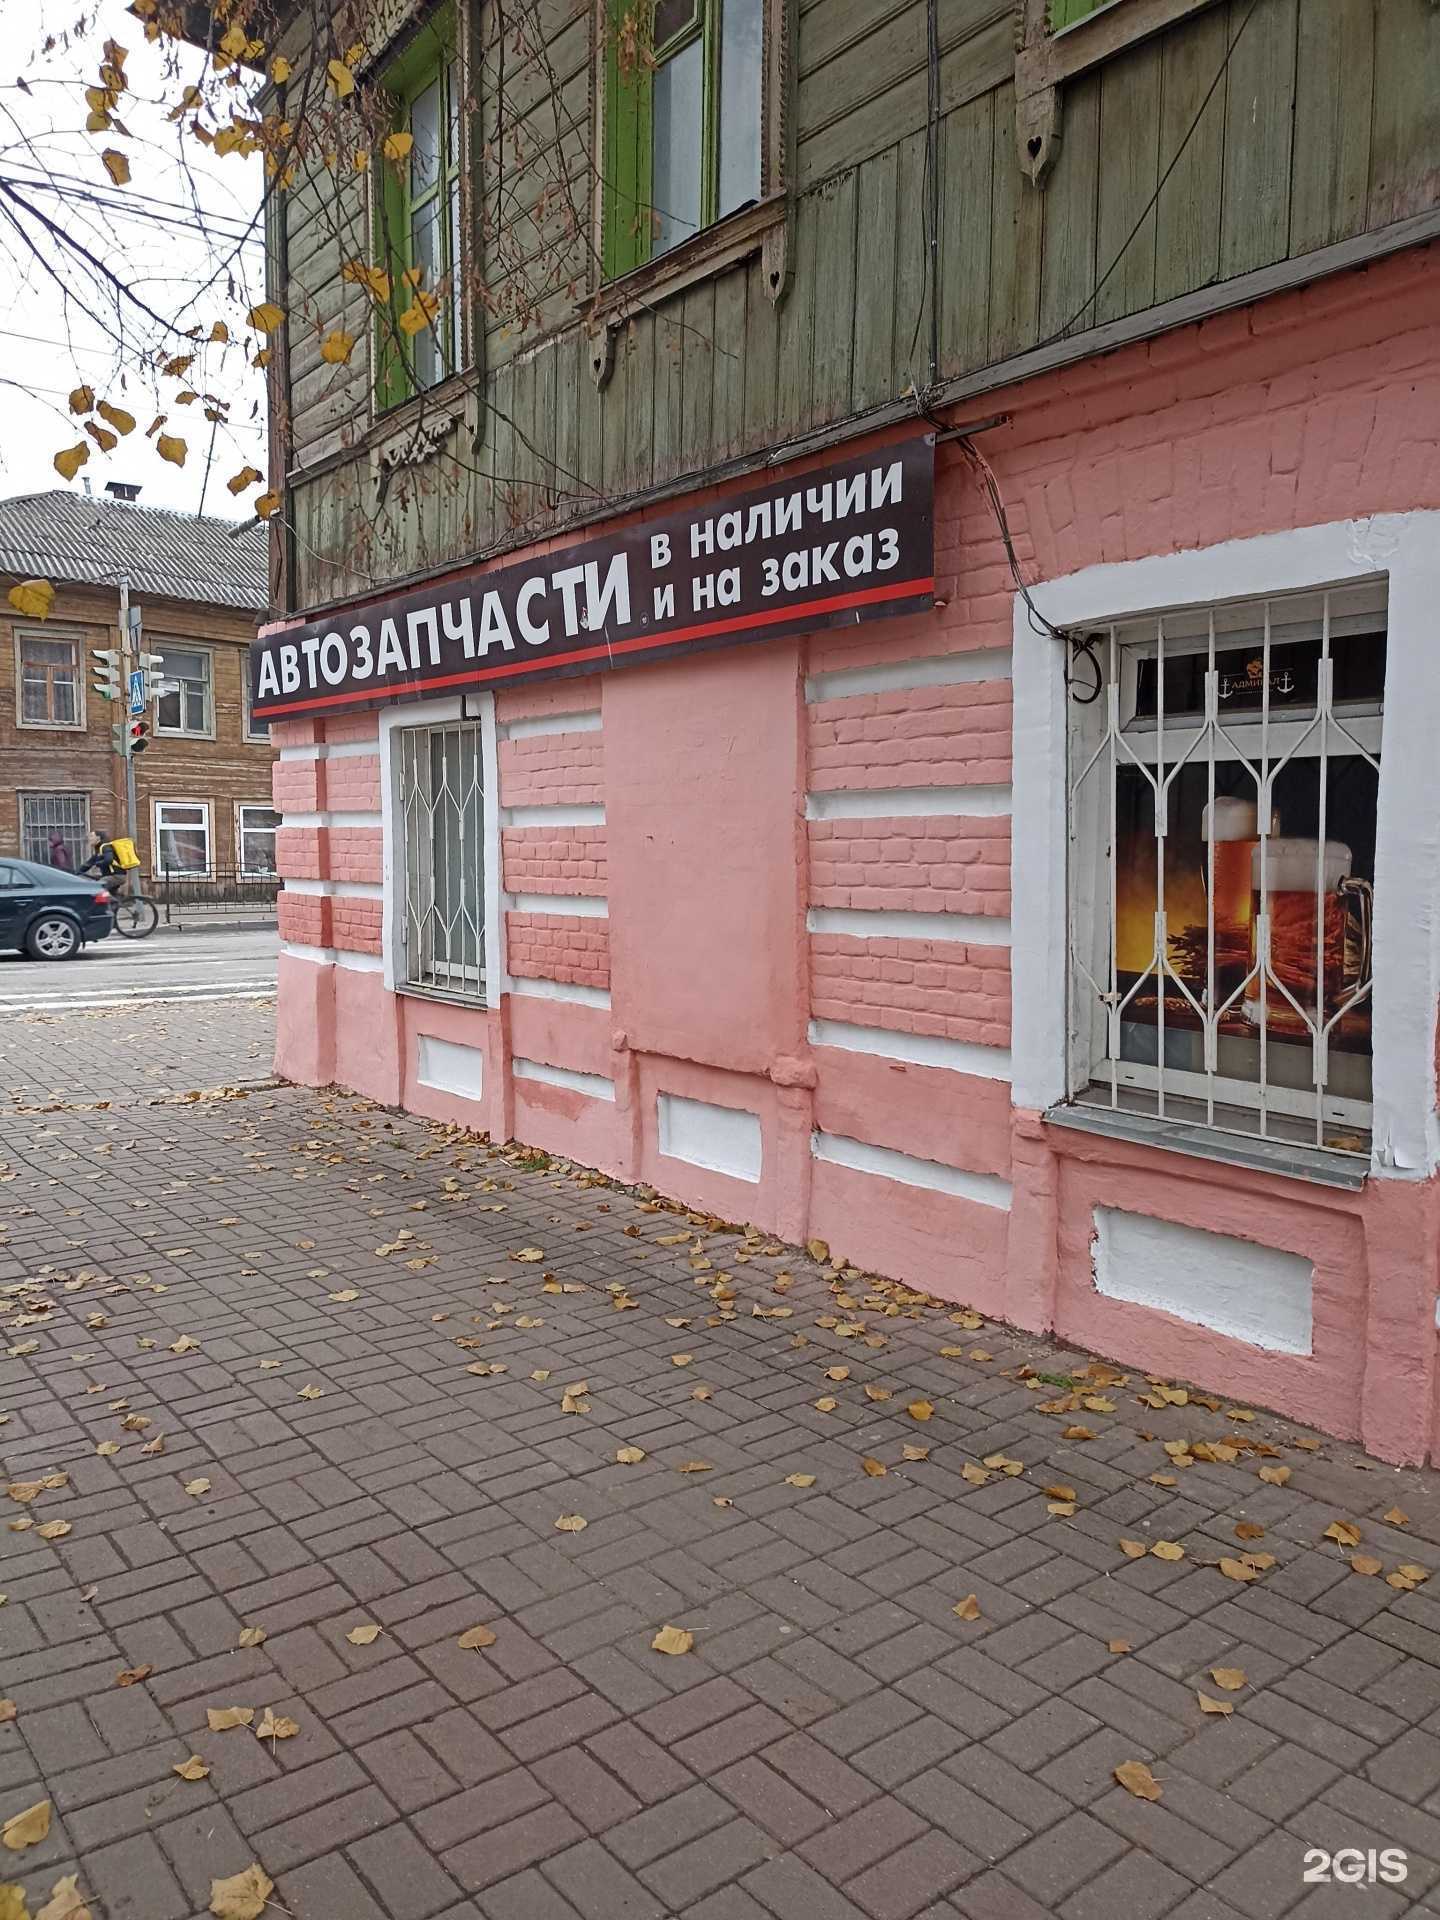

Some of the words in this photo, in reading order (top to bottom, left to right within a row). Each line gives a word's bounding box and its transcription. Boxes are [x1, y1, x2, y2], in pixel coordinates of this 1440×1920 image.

[690, 461, 903, 558] наличии
[653, 584, 675, 620] и
[692, 567, 741, 612] на
[761, 528, 900, 596] заказ
[257, 552, 632, 699] АВТОЗАПЧАСТИ
